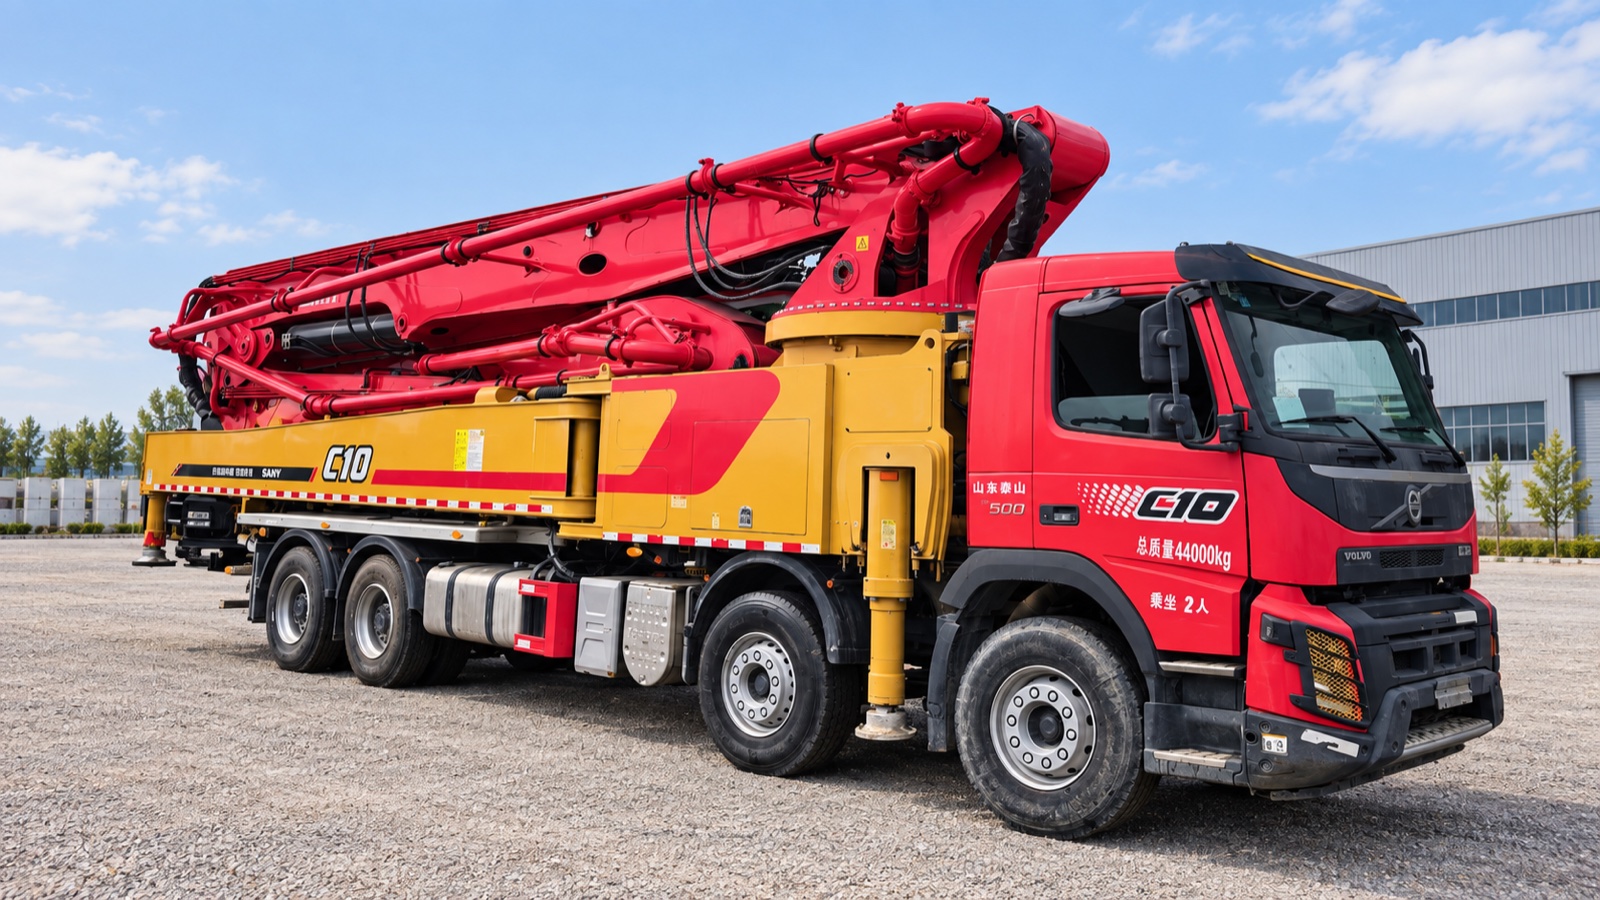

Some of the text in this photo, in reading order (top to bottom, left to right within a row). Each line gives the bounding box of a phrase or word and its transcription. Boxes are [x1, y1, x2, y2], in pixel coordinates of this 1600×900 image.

[323, 445, 374, 482] C10
[261, 468, 282, 478] SANY
[973, 481, 1026, 494] 山东泰山
[989, 502, 1025, 515] 500
[1133, 487, 1239, 524] C10
[1136, 536, 1232, 571] 总质量44000kg
[1344, 551, 1372, 560] VOLVO
[1150, 592, 1177, 611] 乘坐
